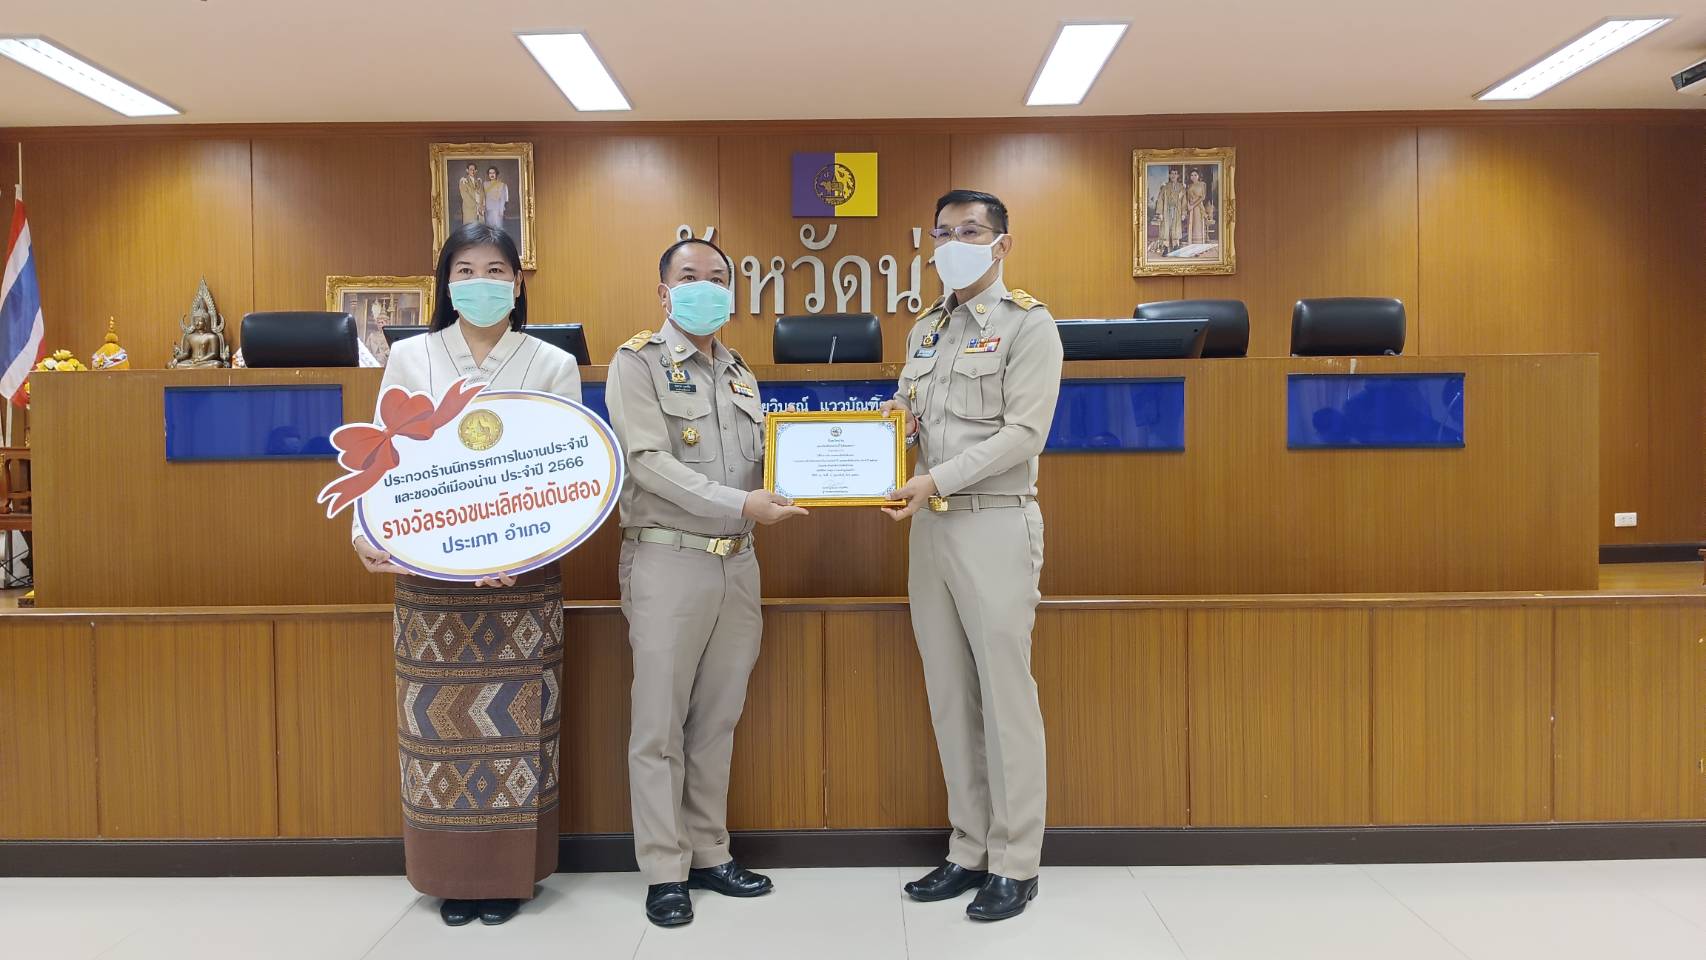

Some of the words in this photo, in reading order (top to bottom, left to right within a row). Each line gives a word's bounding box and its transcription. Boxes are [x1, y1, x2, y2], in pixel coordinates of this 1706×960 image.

[384, 435, 589, 487] ประกวดร้านนิทรรศการในงานประจำปี
[395, 474, 497, 504] และของดีเมืองน่าน
[501, 461, 544, 482] ประจำปี
[548, 456, 584, 473] 2566
[382, 478, 602, 540] รางวัลรองชนะเลิศอันดับสอง
[442, 531, 498, 553] ประเภท
[505, 521, 551, 541] อำเภอ
